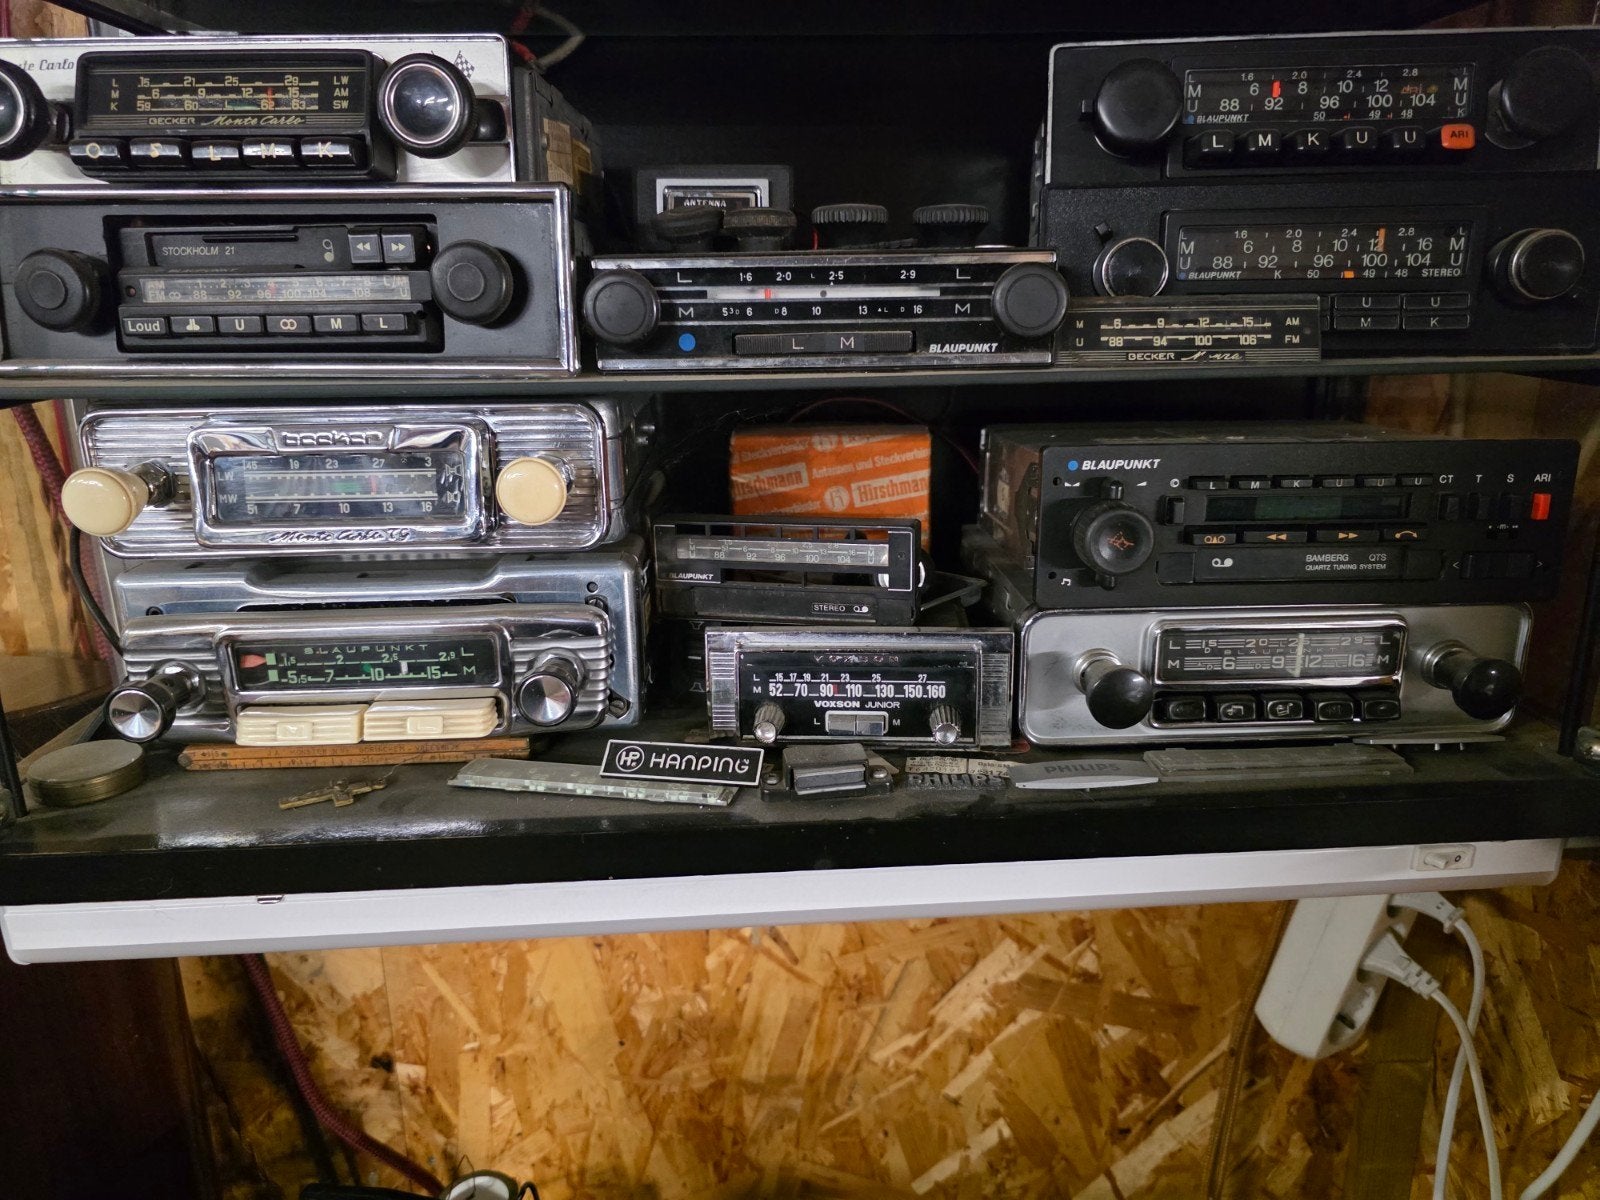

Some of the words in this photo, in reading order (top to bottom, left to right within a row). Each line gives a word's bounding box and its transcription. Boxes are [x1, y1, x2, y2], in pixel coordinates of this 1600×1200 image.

[39, 59, 75, 71] Carlo
[1402, 68, 1418, 77] 2.8
[184, 76, 196, 87] 21
[224, 76, 239, 87] 25
[284, 75, 299, 86] 29
[333, 75, 350, 86] LW
[1250, 83, 1259, 95] 6
[1298, 82, 1308, 94] 8
[1337, 80, 1353, 93] 10
[1375, 79, 1389, 92] 12
[1454, 77, 1468, 91] M
[241, 88, 254, 98] 12
[287, 87, 300, 98] 15
[333, 88, 349, 97] AM
[184, 101, 199, 111] 60
[291, 100, 306, 111] 63
[333, 100, 349, 109] SW
[1219, 99, 1240, 111] 88
[1264, 98, 1283, 110] 92
[1319, 96, 1340, 109] 96
[1366, 94, 1393, 108] 100
[1410, 93, 1437, 106] 104
[149, 117, 196, 125] BECKER
[201, 115, 258, 126] Monte
[260, 115, 306, 126] Carlo
[1196, 113, 1251, 124] BLAUPUNKT
[1212, 135, 1225, 148] L
[1258, 134, 1273, 147] M
[1307, 133, 1320, 145] K
[1356, 131, 1368, 144] U
[1404, 130, 1416, 143] U
[209, 145, 222, 161] L
[260, 143, 276, 158] M
[318, 141, 333, 157] K
[683, 199, 728, 208] ANTENNA
[1285, 229, 1303, 238] 2.0
[1341, 228, 1357, 237] 2.4
[1398, 227, 1415, 236] 2.8
[162, 246, 219, 256] STOCKHOLM
[225, 246, 236, 255] 21
[1180, 242, 1194, 255] M
[1243, 240, 1254, 254] 6
[1291, 239, 1302, 253] 8
[1332, 239, 1348, 252] 10
[1369, 238, 1383, 252] 12
[1417, 237, 1433, 251] 16
[1450, 237, 1465, 251] M
[1180, 257, 1191, 270] U
[1212, 256, 1233, 269] 88
[1258, 255, 1278, 268] 92
[1313, 254, 1334, 268] 96
[1361, 253, 1388, 267] 100
[1405, 252, 1432, 266] 104
[1451, 252, 1463, 266] U
[1188, 271, 1243, 280] BLAUPUNKT
[1306, 270, 1320, 279] 50
[1362, 268, 1376, 278] 49
[1394, 268, 1409, 278] 48
[1421, 267, 1461, 277] STEREO
[193, 290, 207, 300] 88
[227, 290, 242, 299] 92
[256, 289, 272, 299] 96
[679, 306, 694, 318] M
[811, 305, 822, 316] 10
[858, 305, 868, 315] 13
[913, 304, 923, 314] 16
[955, 303, 971, 314] M
[127, 320, 161, 332] Loud
[330, 318, 342, 330] M
[1198, 317, 1210, 328] 12
[1242, 316, 1254, 327] 15
[1285, 317, 1300, 326] AM
[840, 336, 855, 349] M
[929, 342, 999, 353] BLAUPUNKT
[1108, 336, 1124, 347] 88
[1153, 336, 1168, 347] 94
[1195, 335, 1213, 346] 100
[1239, 335, 1258, 345] 106
[1284, 335, 1300, 344] FM
[1128, 352, 1175, 361] BECKER
[289, 459, 300, 470] 19
[325, 458, 339, 469] 23
[372, 458, 385, 469] 27
[1081, 458, 1162, 471] BLAUPUNKT
[1439, 474, 1454, 484] CT
[1534, 473, 1552, 483] ARI
[247, 504, 258, 515] 51
[338, 503, 350, 514] 10
[383, 502, 394, 513] 13
[421, 501, 433, 512] 16
[1305, 553, 1349, 563] BAMBERG
[1305, 563, 1331, 571] QUARTZ
[1333, 563, 1357, 571] TUNING
[814, 604, 846, 612] STEREO
[304, 644, 428, 655] BLAUPUNKT
[1304, 655, 1322, 668] 12
[370, 668, 385, 682] 10
[426, 666, 441, 680] 15
[463, 666, 476, 676] M
[775, 673, 783, 682] 15
[789, 673, 797, 681] 17
[803, 673, 811, 681] 19
[820, 674, 829, 682] 21
[840, 674, 850, 682] 23
[871, 674, 881, 682] 25
[918, 674, 927, 683] 27
[769, 683, 783, 697] 52
[794, 684, 808, 697] 70
[819, 684, 834, 697] 90
[845, 684, 863, 697] 110
[875, 684, 894, 698] 130
[904, 684, 923, 698] 150
[926, 685, 946, 698] 160
[813, 700, 860, 708] VOXSON
[864, 700, 901, 709] JUNIOR
[650, 752, 750, 774] HANPING
[1044, 763, 1120, 774] PHILIPS
